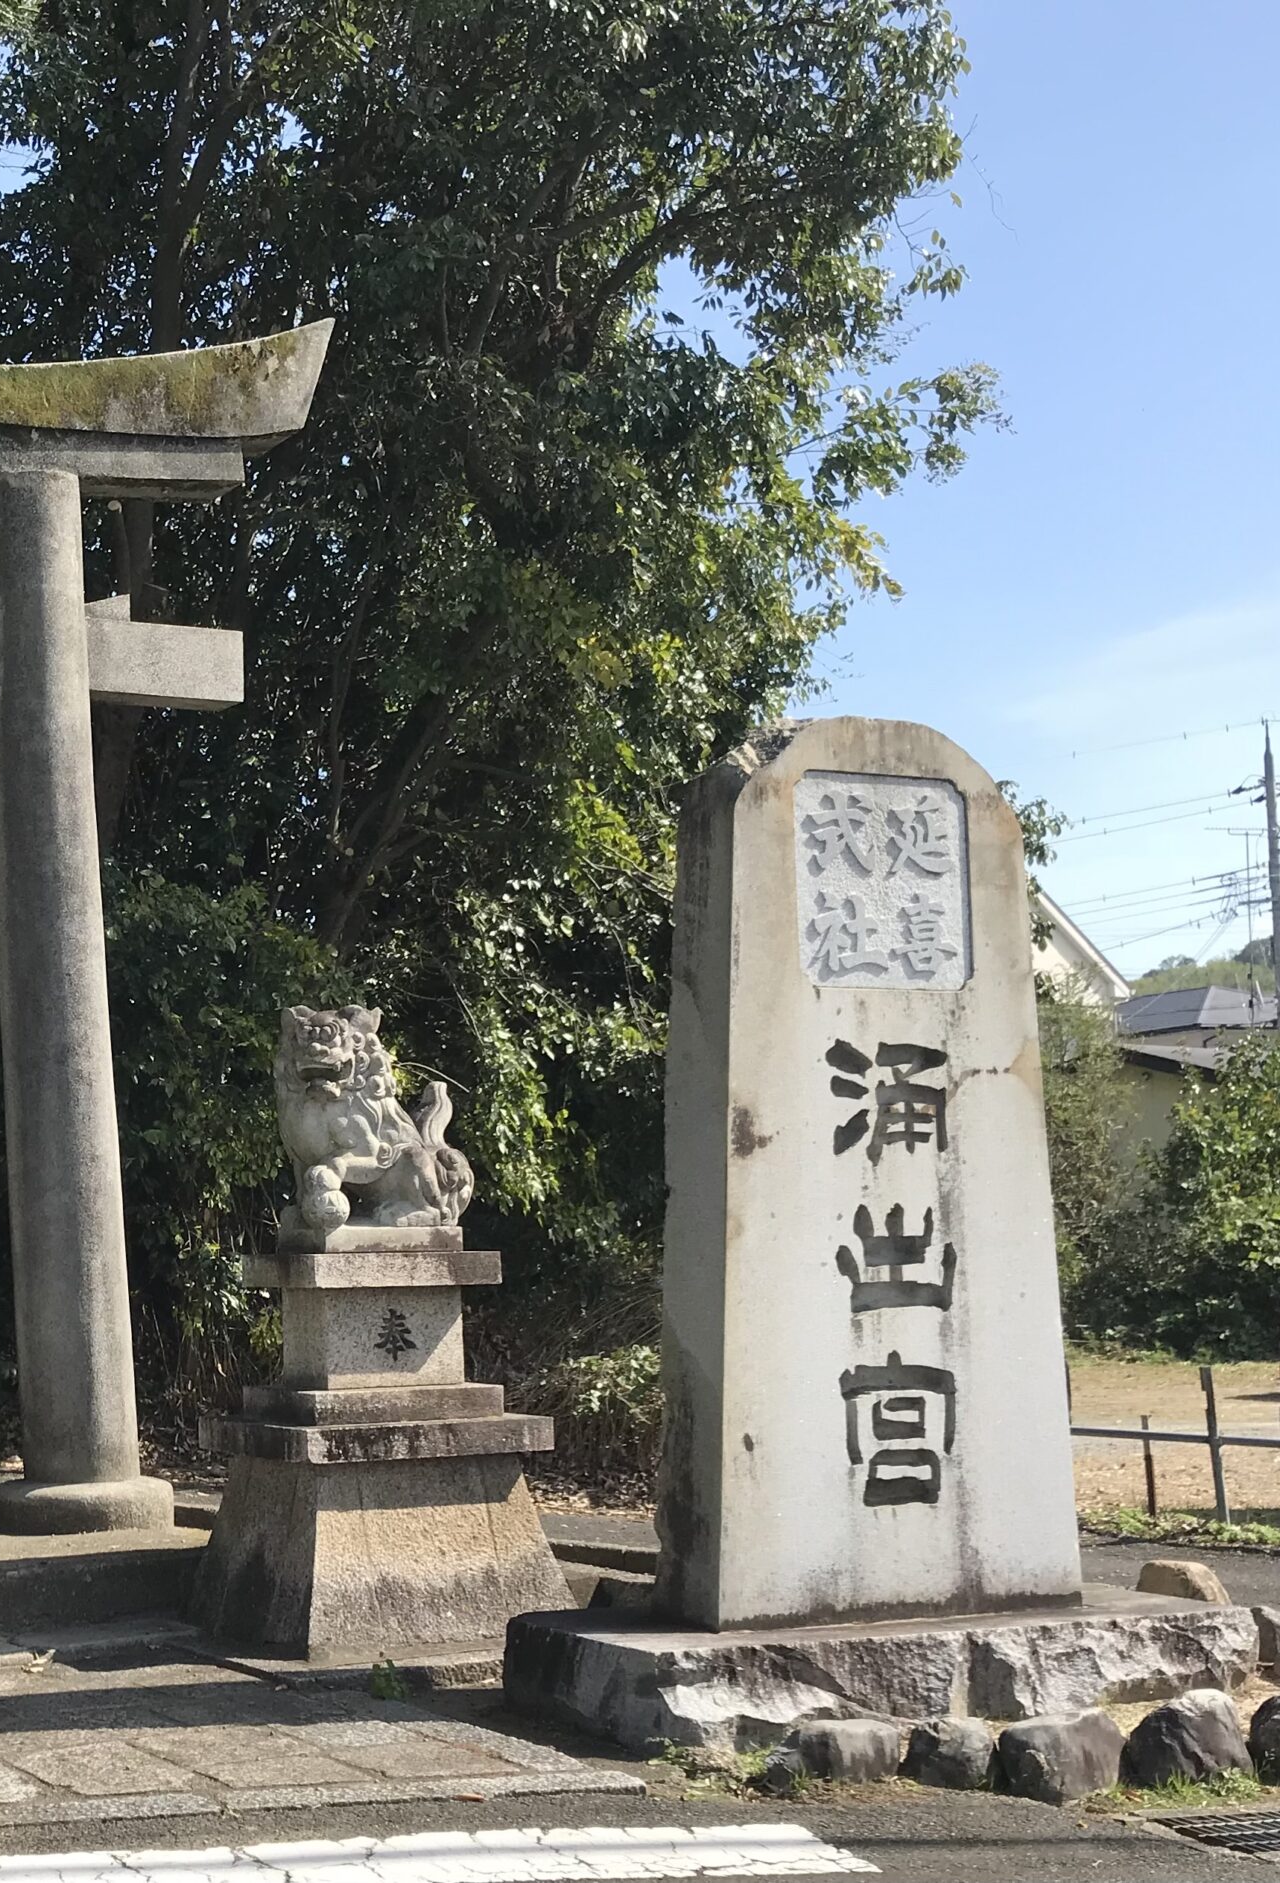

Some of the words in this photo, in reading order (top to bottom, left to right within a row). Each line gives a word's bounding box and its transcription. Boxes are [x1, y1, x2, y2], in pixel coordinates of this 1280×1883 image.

[800, 790, 889, 982] 式社
[883, 794, 958, 982] 延喜
[373, 1308, 418, 1362] 奉
[825, 1038, 957, 1508] 涌出宮
